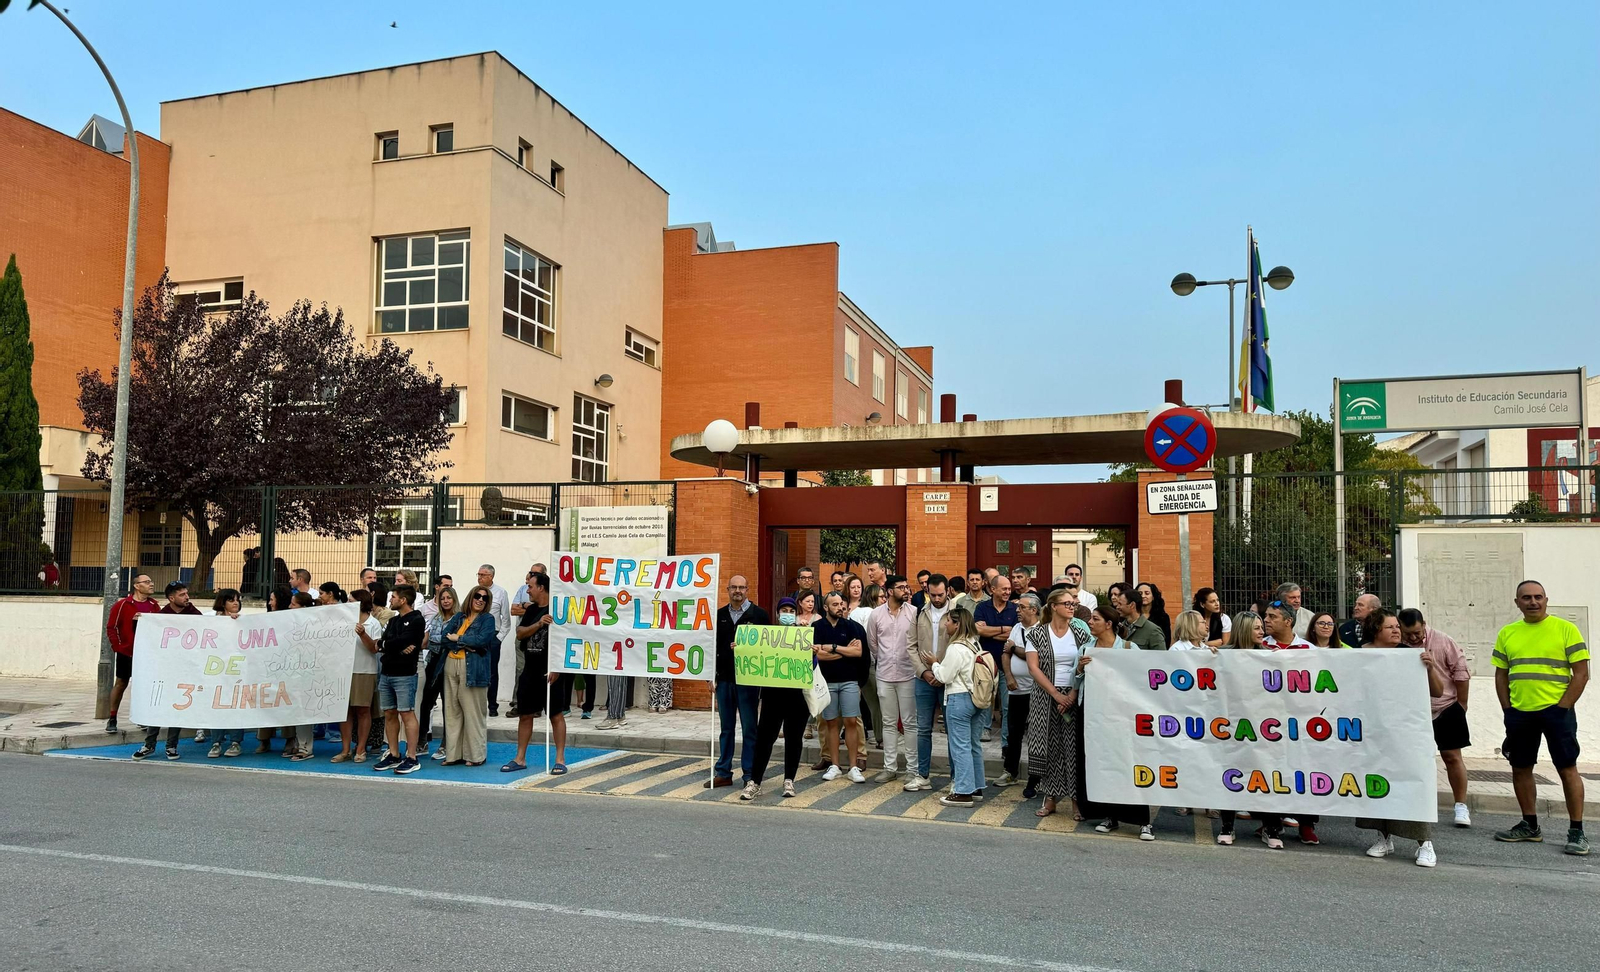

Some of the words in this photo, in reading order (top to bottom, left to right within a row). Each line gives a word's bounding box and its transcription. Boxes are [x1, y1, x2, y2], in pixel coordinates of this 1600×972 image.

[1417, 393, 1454, 404] Instituto
[1456, 392, 1467, 402] de
[1469, 391, 1515, 402] Educación
[1517, 389, 1568, 400] Secundaria
[1493, 404, 1525, 415] Camilo
[1526, 402, 1547, 414] José
[1549, 402, 1569, 413] Cela
[1159, 485, 1176, 493] ZONA
[1177, 483, 1213, 492] SEÑALIZADA
[1163, 493, 1189, 502] SALIDA
[1190, 492, 1201, 501] DE
[1159, 501, 1207, 511] EMERGENCIA
[558, 555, 714, 590] QUEREMOS
[632, 590, 714, 631] LÍNEA
[160, 626, 219, 650] POR
[237, 627, 279, 650] UNA
[292, 623, 356, 642] educación
[736, 625, 759, 646] NO
[759, 626, 814, 652] AULAS
[203, 655, 246, 676] DE
[267, 650, 320, 673] calidad
[563, 637, 600, 671] EN
[646, 641, 705, 676] ESO
[1148, 668, 1217, 691] POR
[1262, 669, 1338, 693] UNA
[211, 679, 293, 710] LÍNEA
[1135, 707, 1362, 742] EDUCACIÓN
[1133, 765, 1178, 788] DE
[1222, 768, 1390, 799] CALIDAD
